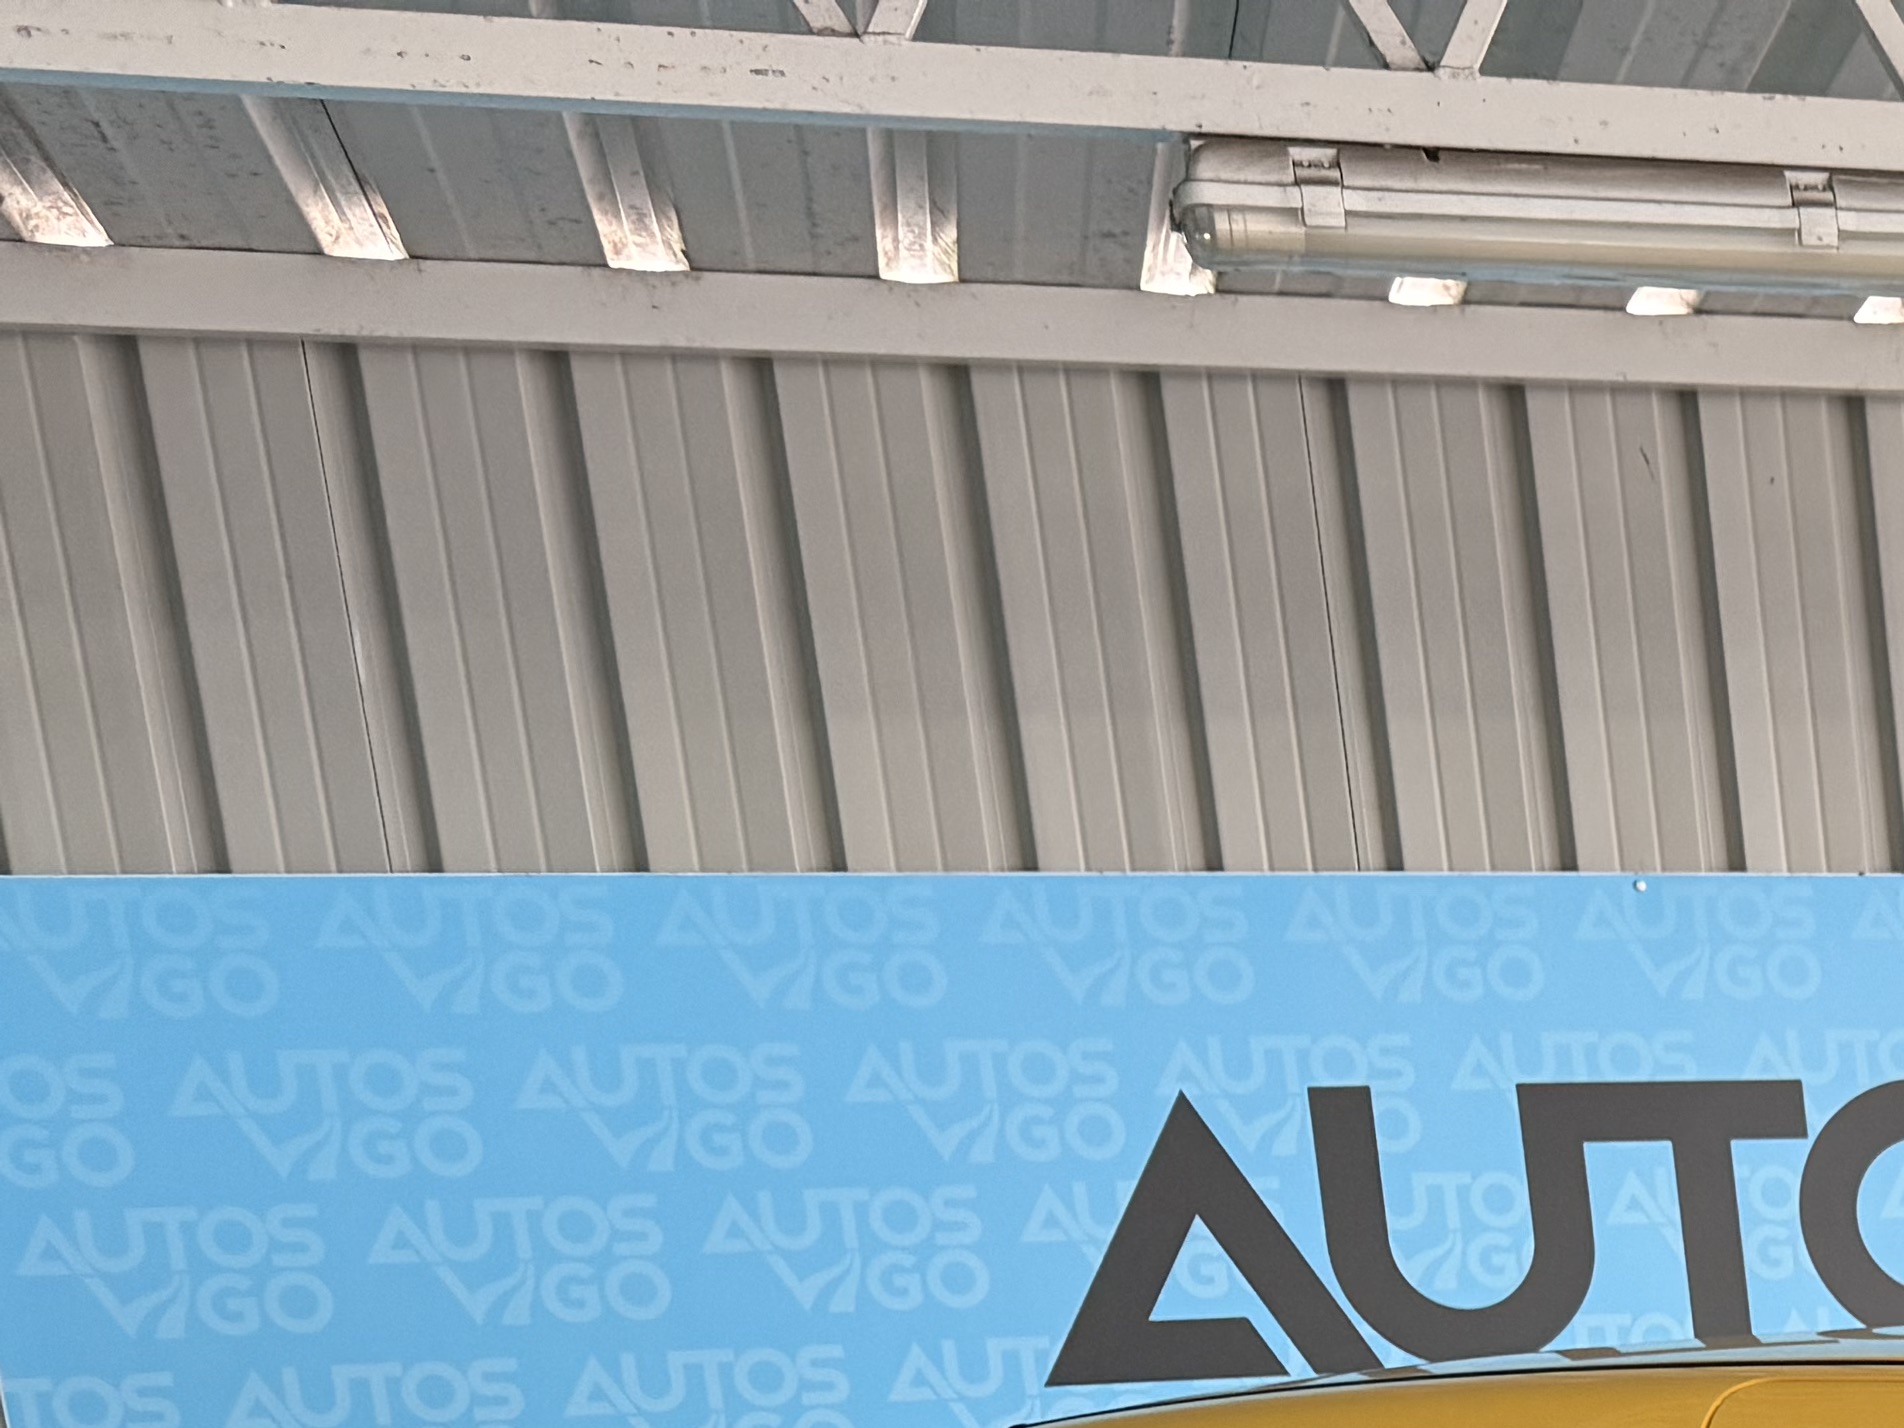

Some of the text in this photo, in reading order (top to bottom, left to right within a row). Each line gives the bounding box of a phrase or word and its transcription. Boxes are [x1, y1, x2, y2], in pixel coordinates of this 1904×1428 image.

[314, 882, 614, 949] AUTOS
[655, 881, 940, 946] AUTOS
[978, 881, 1249, 944] AUTOS
[1285, 881, 1541, 942] AUTOS
[1576, 882, 1819, 941] AUTOS
[27, 951, 281, 1019] VIGO
[381, 947, 623, 1014] VIGO
[719, 945, 947, 1009] VIGO
[1039, 943, 1255, 1006] VIGO
[1342, 942, 1547, 1003] VIGO
[1630, 941, 1824, 1000] VIGO
[169, 1048, 473, 1119] AUTOS
[515, 1043, 805, 1111] AUTOS
[844, 1038, 1119, 1104] AUTOS
[1156, 1034, 1417, 1098] AUTOS
[0, 1123, 135, 1192] GO
[237, 1114, 483, 1182] VIGO
[580, 1107, 813, 1172] VIGO
[905, 1101, 1126, 1164] VIGO
[1214, 1095, 1423, 1157] VIO
[15, 1203, 324, 1277] AUTOS
[367, 1193, 661, 1265] AUTOS
[701, 1184, 981, 1253] AUTOS
[432, 1258, 670, 1325] VIGO
[764, 1247, 989, 1312] VIGO
[1388, 1232, 1533, 1290] VIG
[84, 1269, 334, 1339] VIGO
[564, 1345, 848, 1418] AUTOS
[887, 1337, 1052, 1403] AUT
